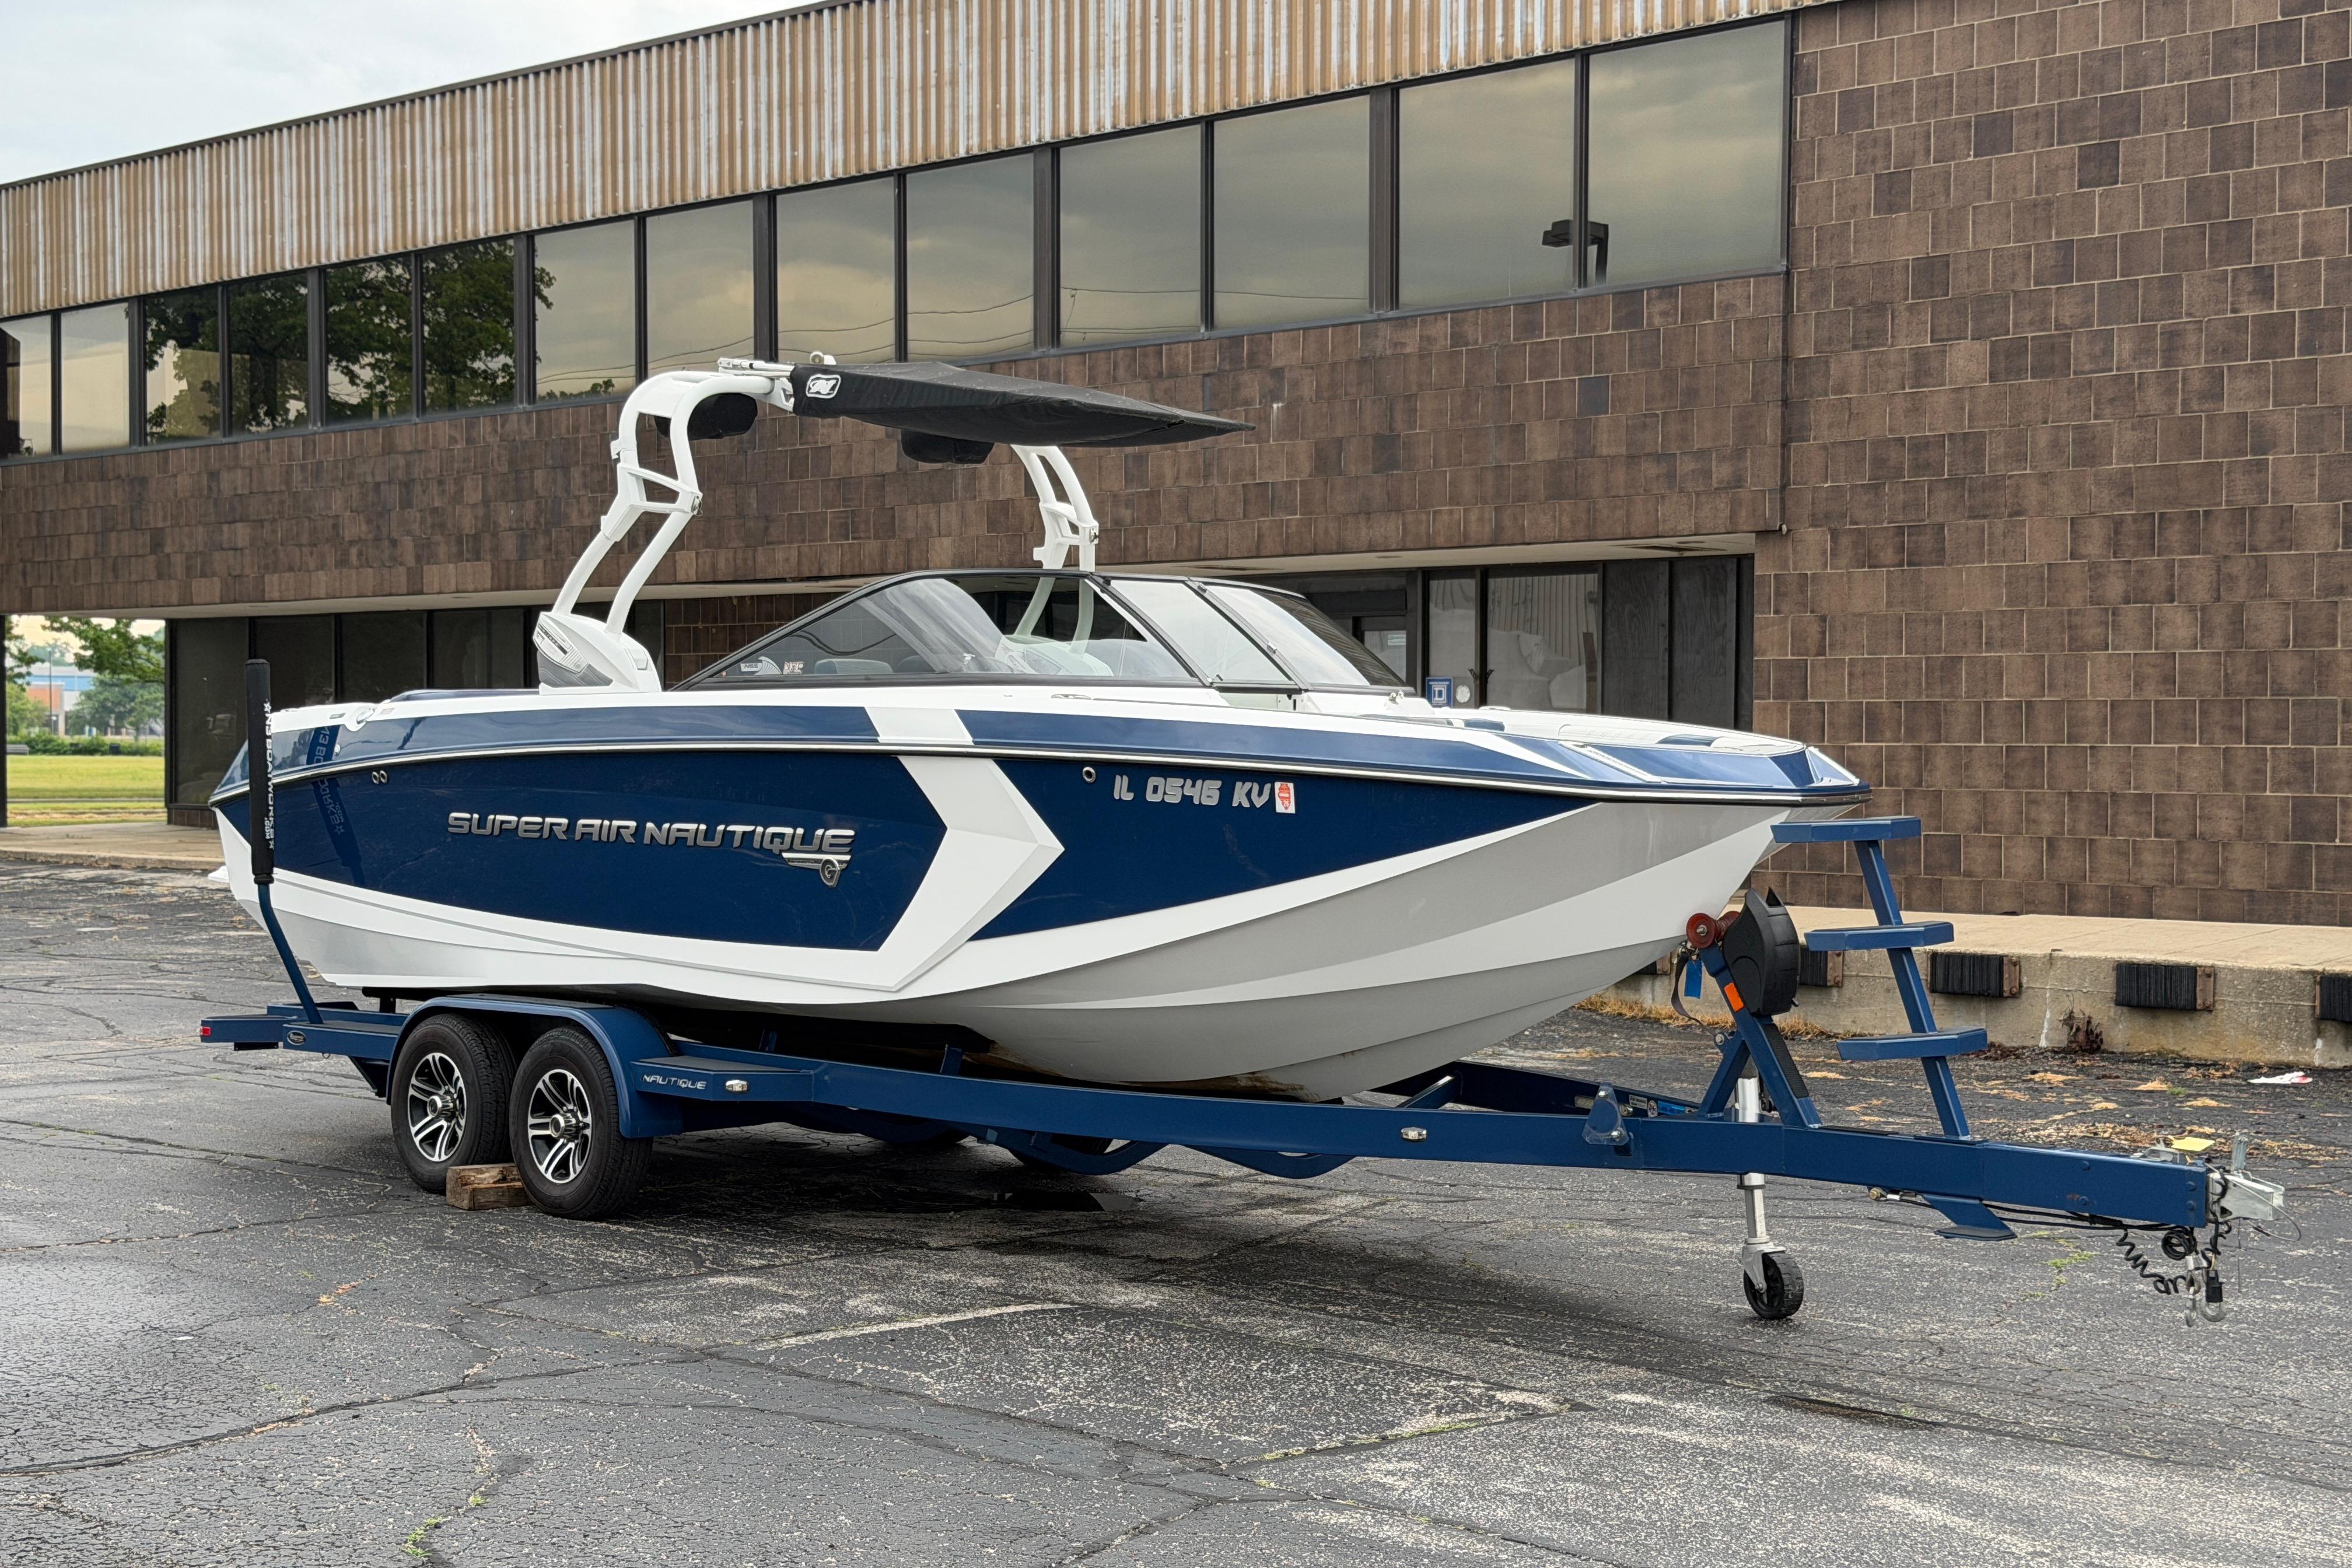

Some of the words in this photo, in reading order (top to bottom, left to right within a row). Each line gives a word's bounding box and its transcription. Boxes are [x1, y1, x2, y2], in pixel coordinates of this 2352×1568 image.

[1113, 774, 1135, 800] IL
[1145, 776, 1222, 806] 0546
[1231, 781, 1272, 808] KV
[448, 812, 569, 840] SUPER
[575, 819, 637, 843] AIR
[643, 822, 855, 855] NAUTIQUE
[642, 1074, 708, 1090] NAUTIQUE
